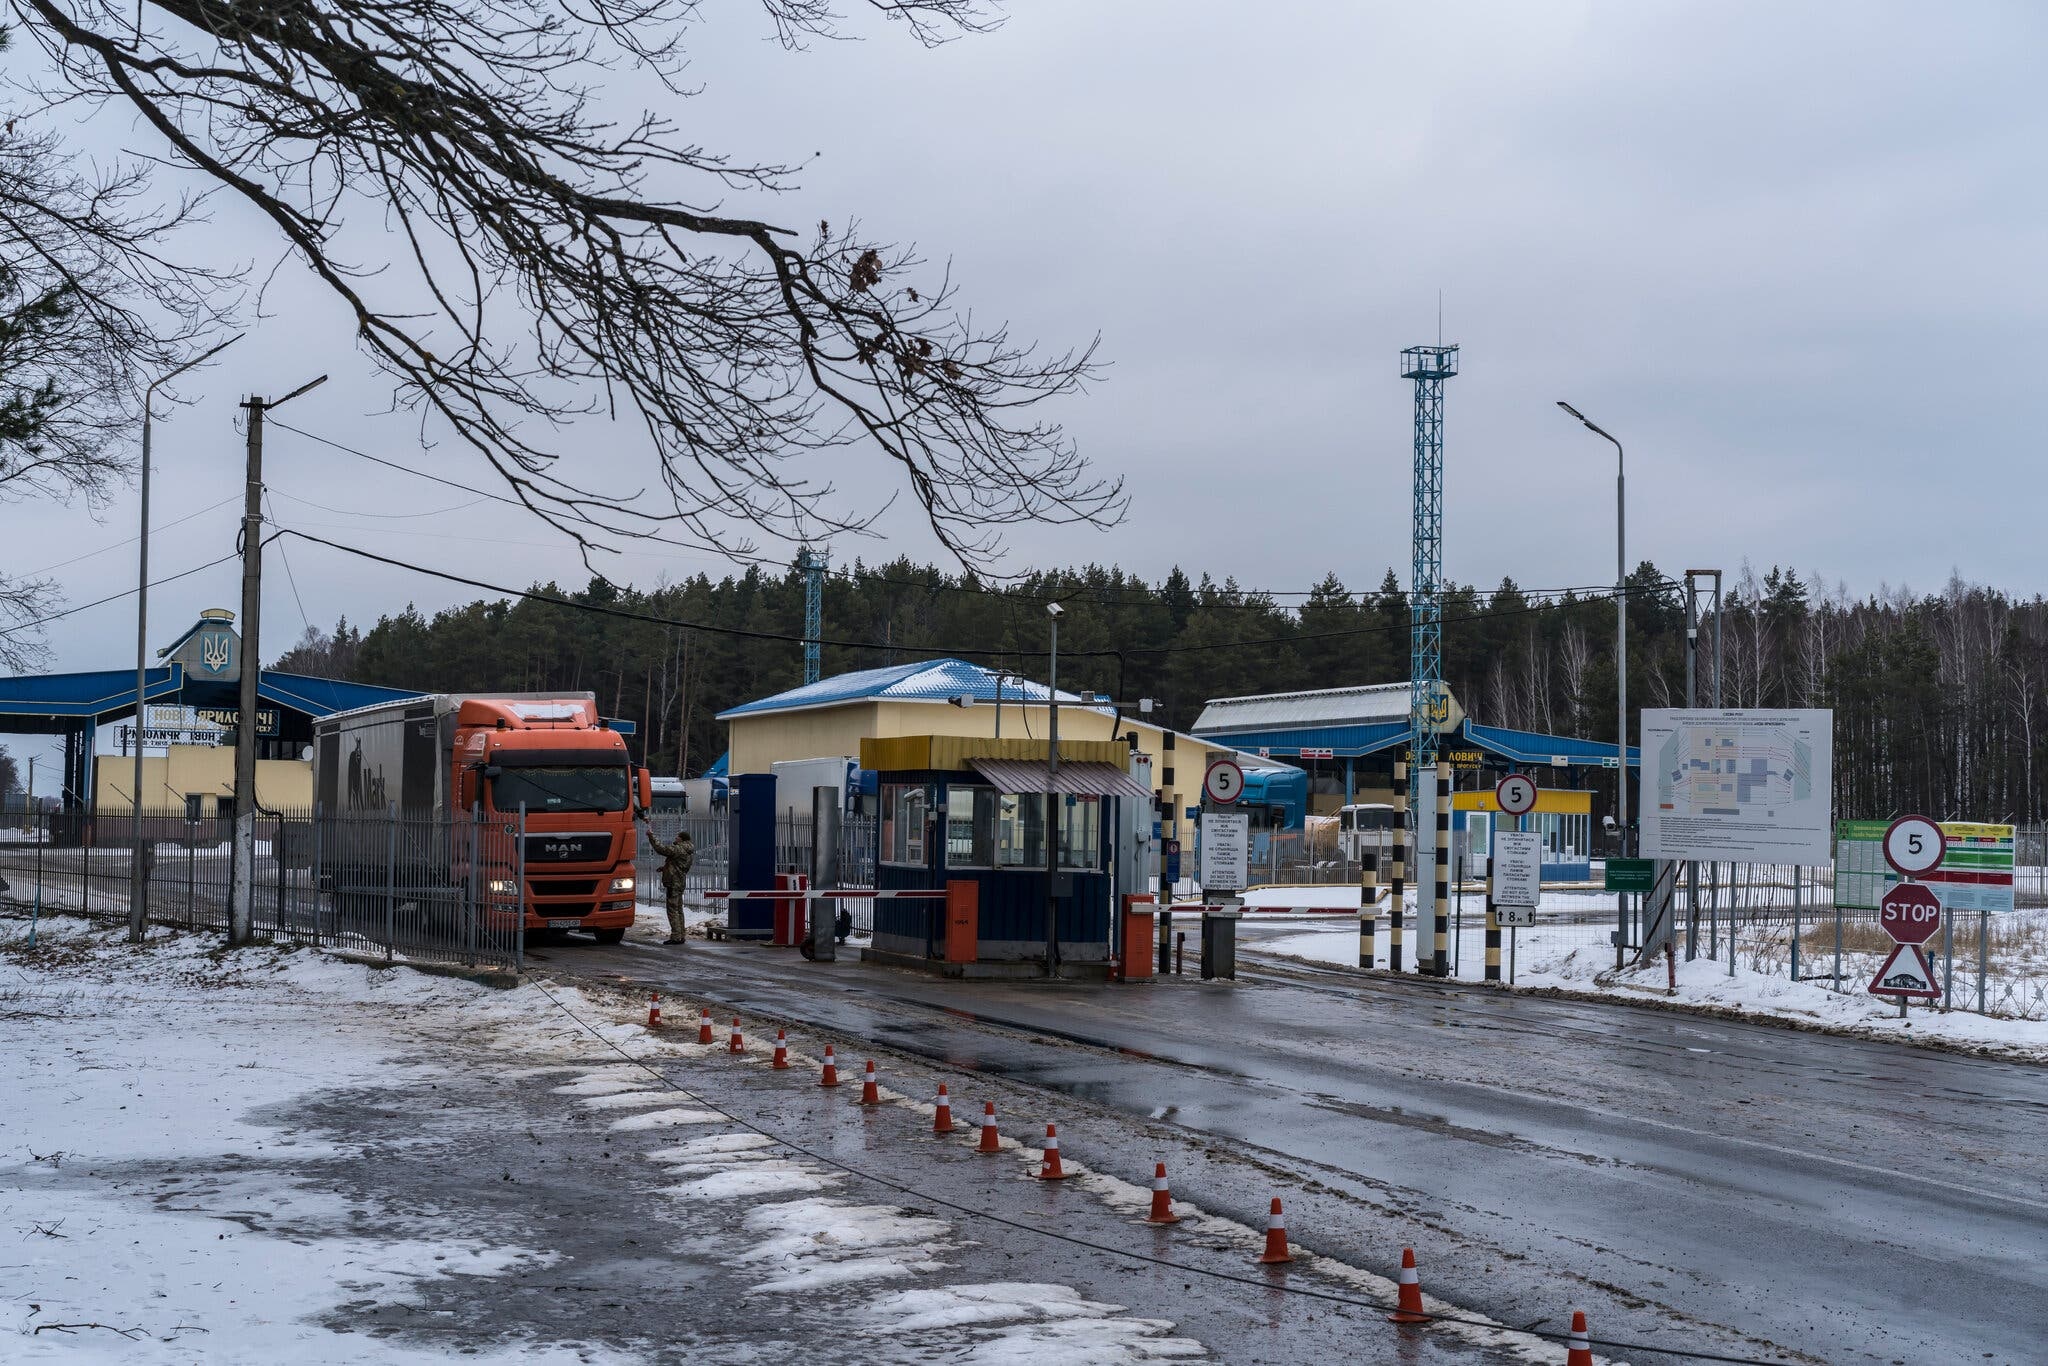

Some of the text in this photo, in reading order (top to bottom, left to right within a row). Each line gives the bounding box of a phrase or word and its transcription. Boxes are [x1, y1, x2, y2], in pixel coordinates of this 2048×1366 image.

[1219, 773, 1230, 790] 5
[1511, 786, 1522, 803] 5
[545, 843, 582, 852] MAN
[1908, 834, 1923, 855] 5
[1508, 911, 1516, 923] 8
[1885, 902, 1937, 923] STOP
